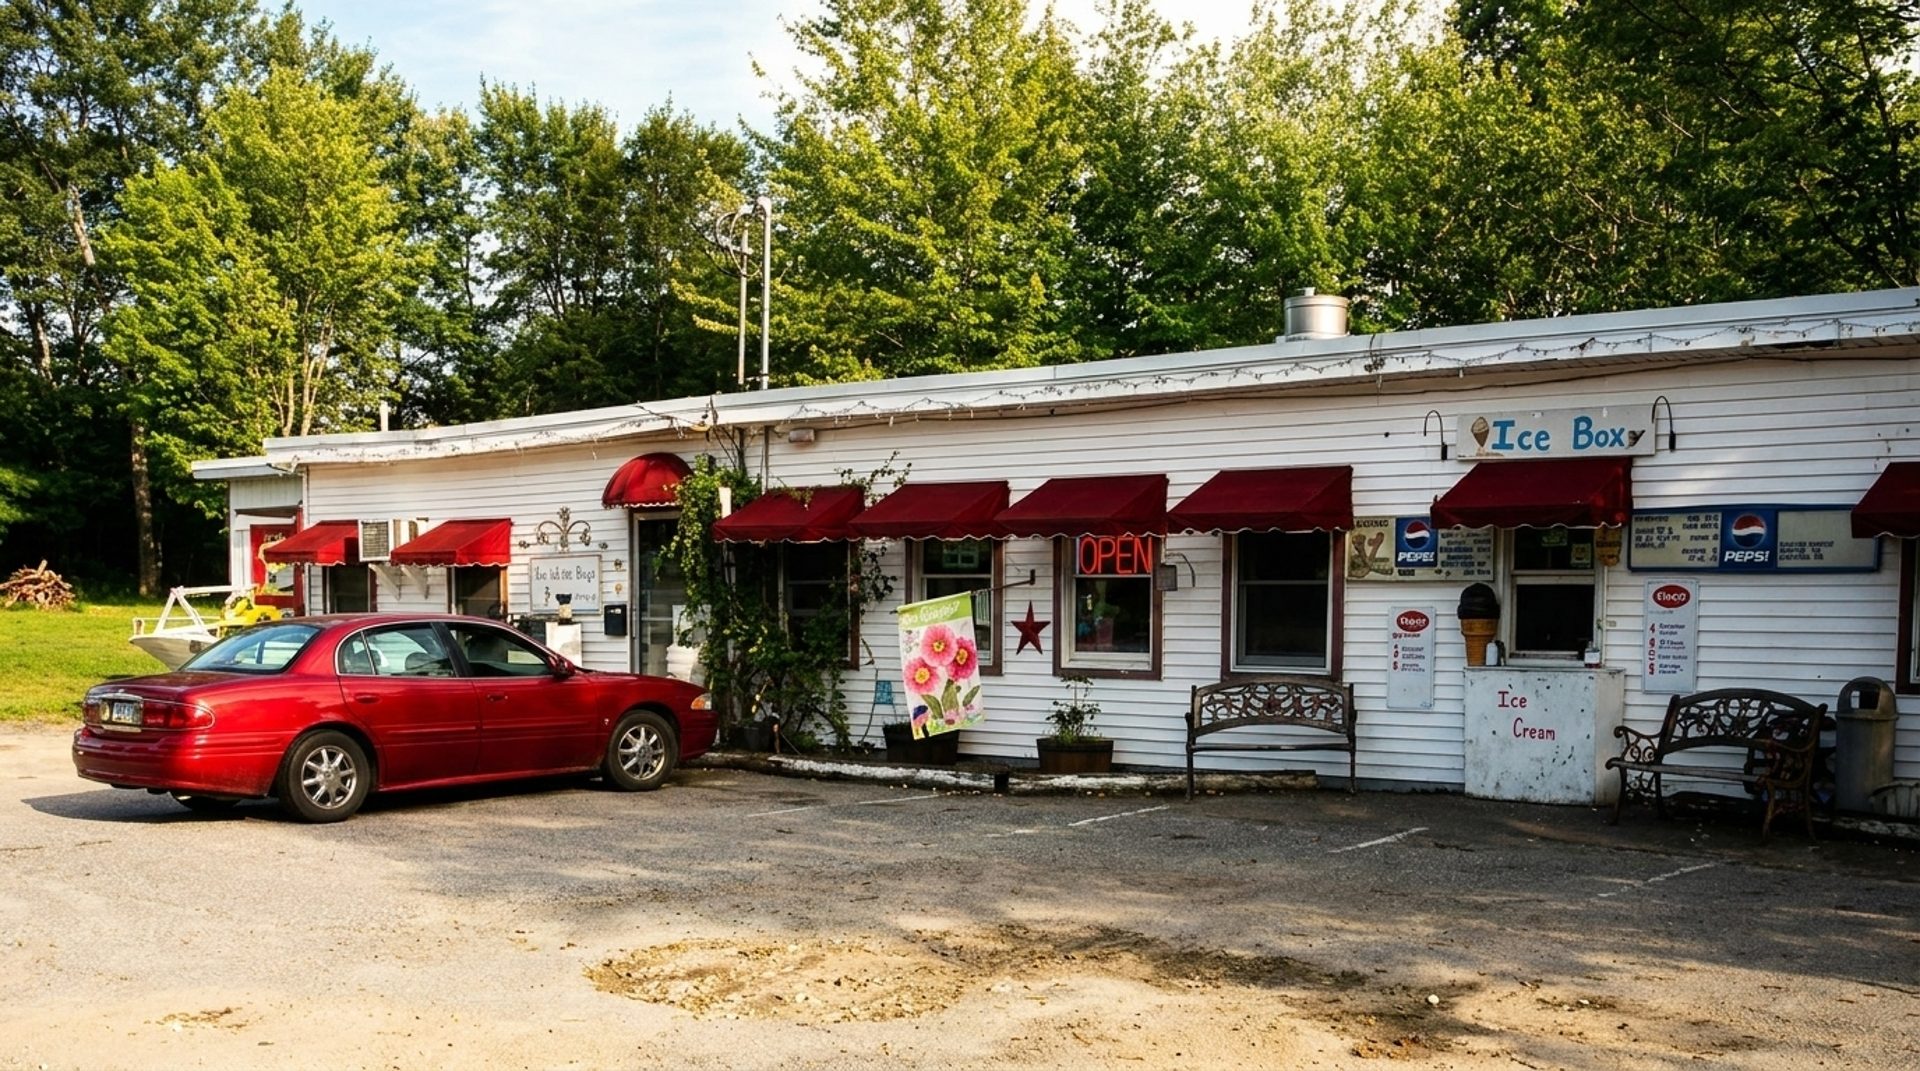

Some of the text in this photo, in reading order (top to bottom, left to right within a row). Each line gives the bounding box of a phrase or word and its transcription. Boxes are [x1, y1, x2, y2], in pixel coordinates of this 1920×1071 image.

[1491, 416, 1626, 451] Ice Box
[1080, 537, 1152, 574] OPEN
[1497, 690, 1528, 708] Ice
[1513, 717, 1556, 740] Cream
